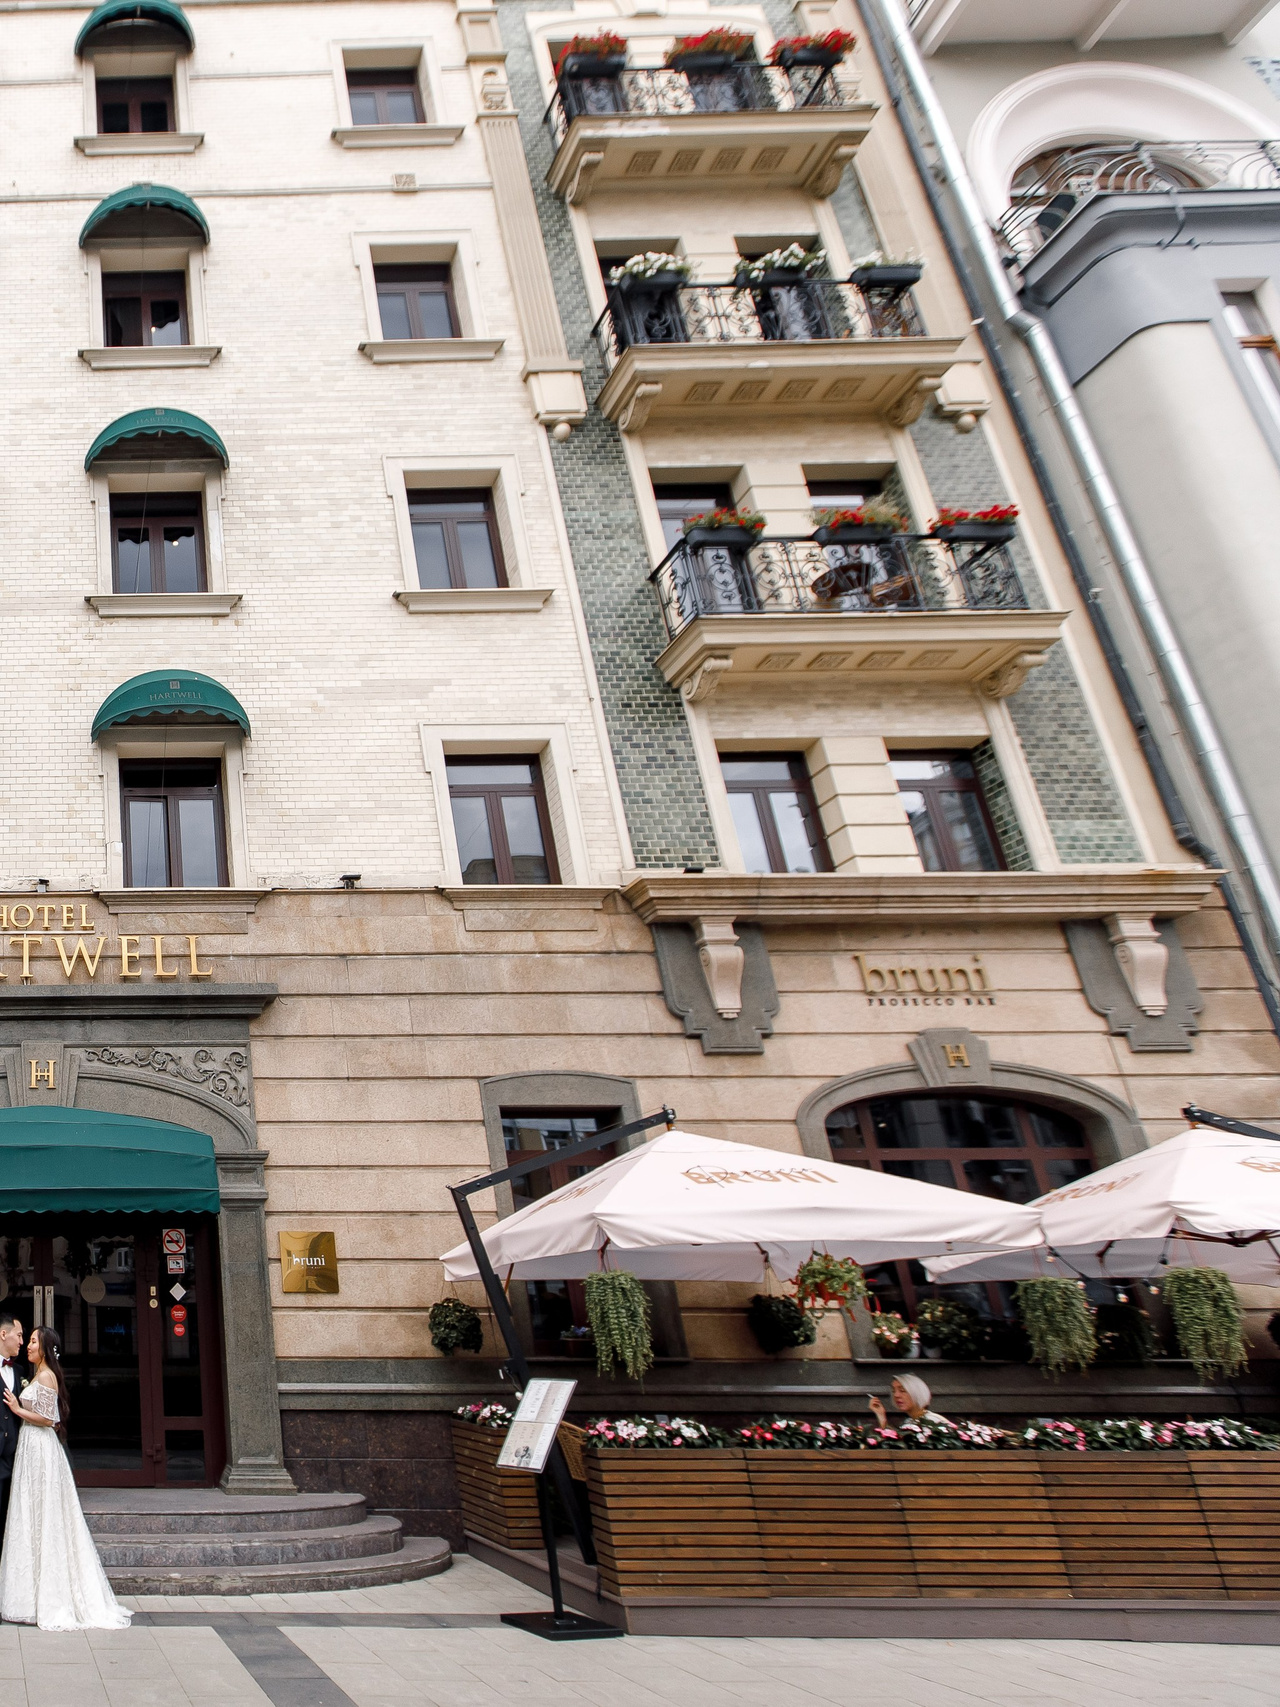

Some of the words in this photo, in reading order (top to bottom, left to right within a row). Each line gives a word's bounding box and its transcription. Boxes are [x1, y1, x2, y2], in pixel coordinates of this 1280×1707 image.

[149, 691, 202, 701] HARTWELL
[852, 953, 995, 993] bruni
[868, 997, 956, 1007] PROSECCO
